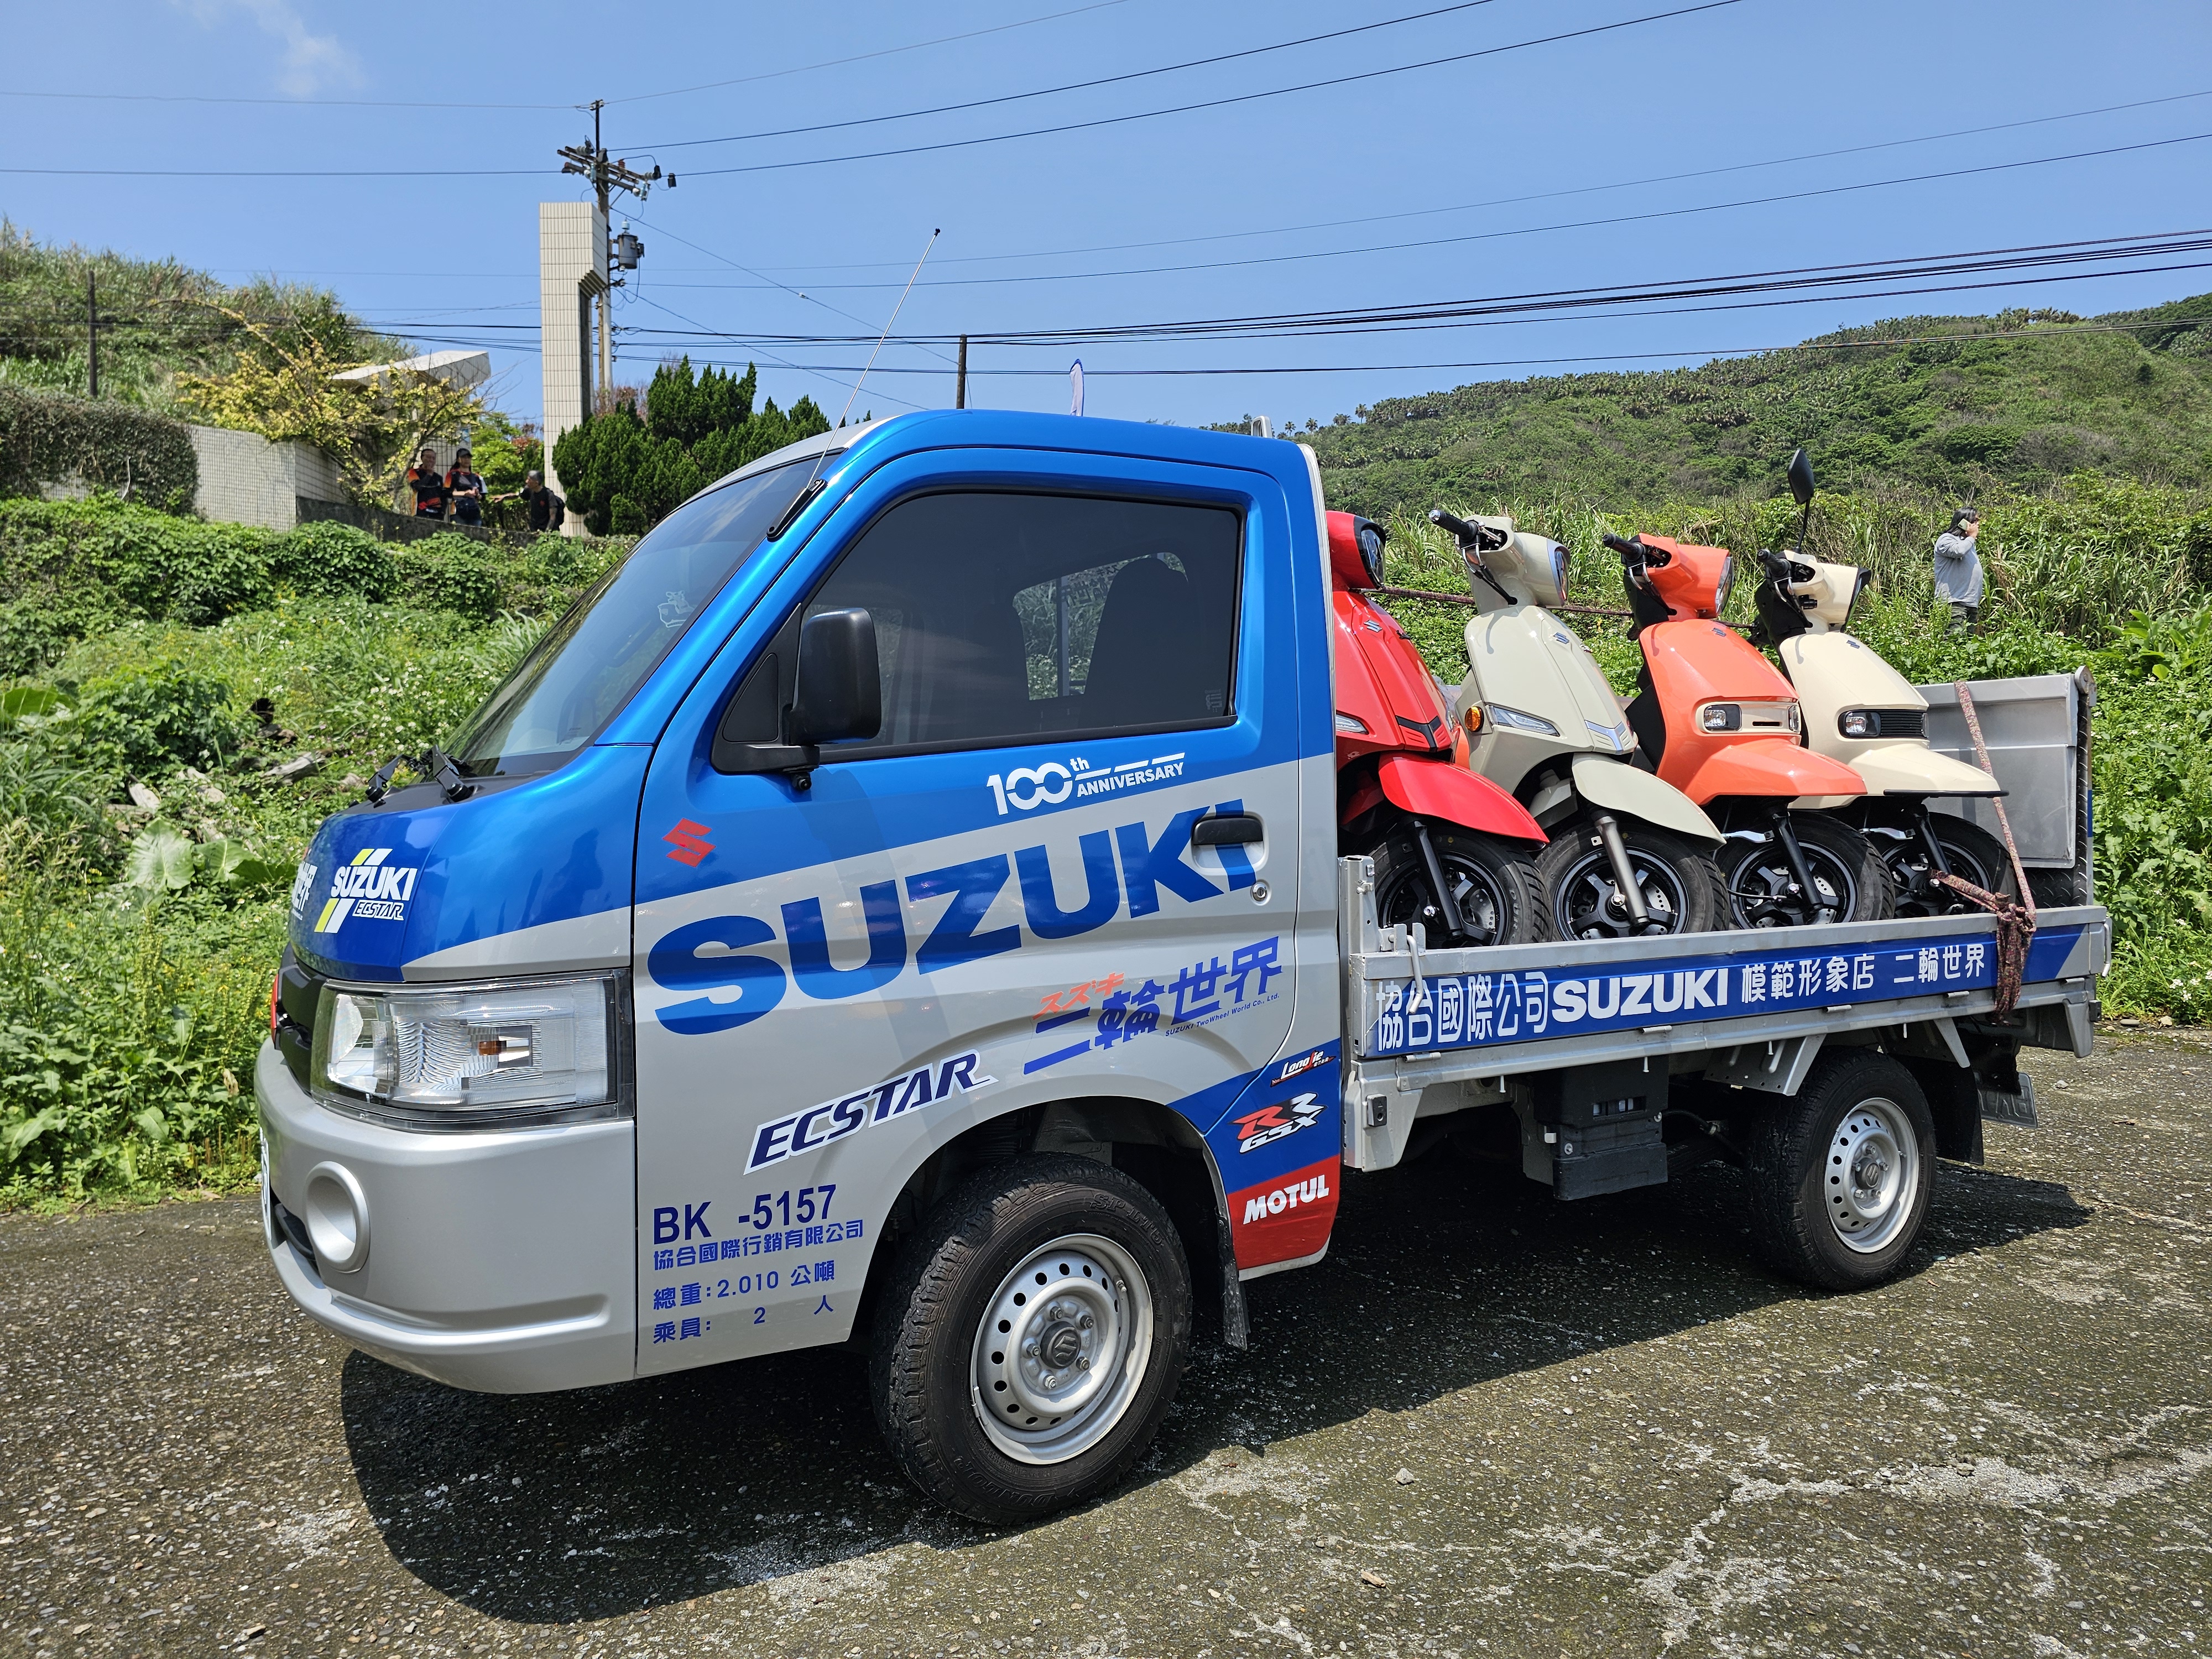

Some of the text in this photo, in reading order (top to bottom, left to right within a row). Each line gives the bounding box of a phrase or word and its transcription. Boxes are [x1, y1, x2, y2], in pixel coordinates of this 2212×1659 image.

[1076, 761, 1185, 797] ANNIVERSARY
[331, 866, 418, 901] SUZUKI
[353, 900, 404, 920] ECSTAR
[649, 799, 1257, 1034] SUZUKI
[1024, 936, 1284, 1075] 二輪世界
[1032, 972, 1125, 1021] スズキ
[1165, 1022, 1194, 1037] SUZUKI
[1196, 1010, 1230, 1027] TwoWheel
[1232, 1002, 1251, 1015] World
[1267, 993, 1280, 1002] Ltd.
[1376, 943, 1985, 1051] 協合國際公司 SUZUKI 模範形象店 二輪世界
[747, 1051, 996, 1171] ECSTAR
[1239, 1109, 1323, 1154] GSX
[653, 1184, 837, 1245] BK -5157
[1243, 1175, 1329, 1225] MOTUL
[653, 1219, 864, 1271] 協合國際行銷有限公司
[754, 1306, 766, 1325] 2
[813, 1295, 834, 1316] 人
[953, 1455, 1057, 1509] DUNLOP
